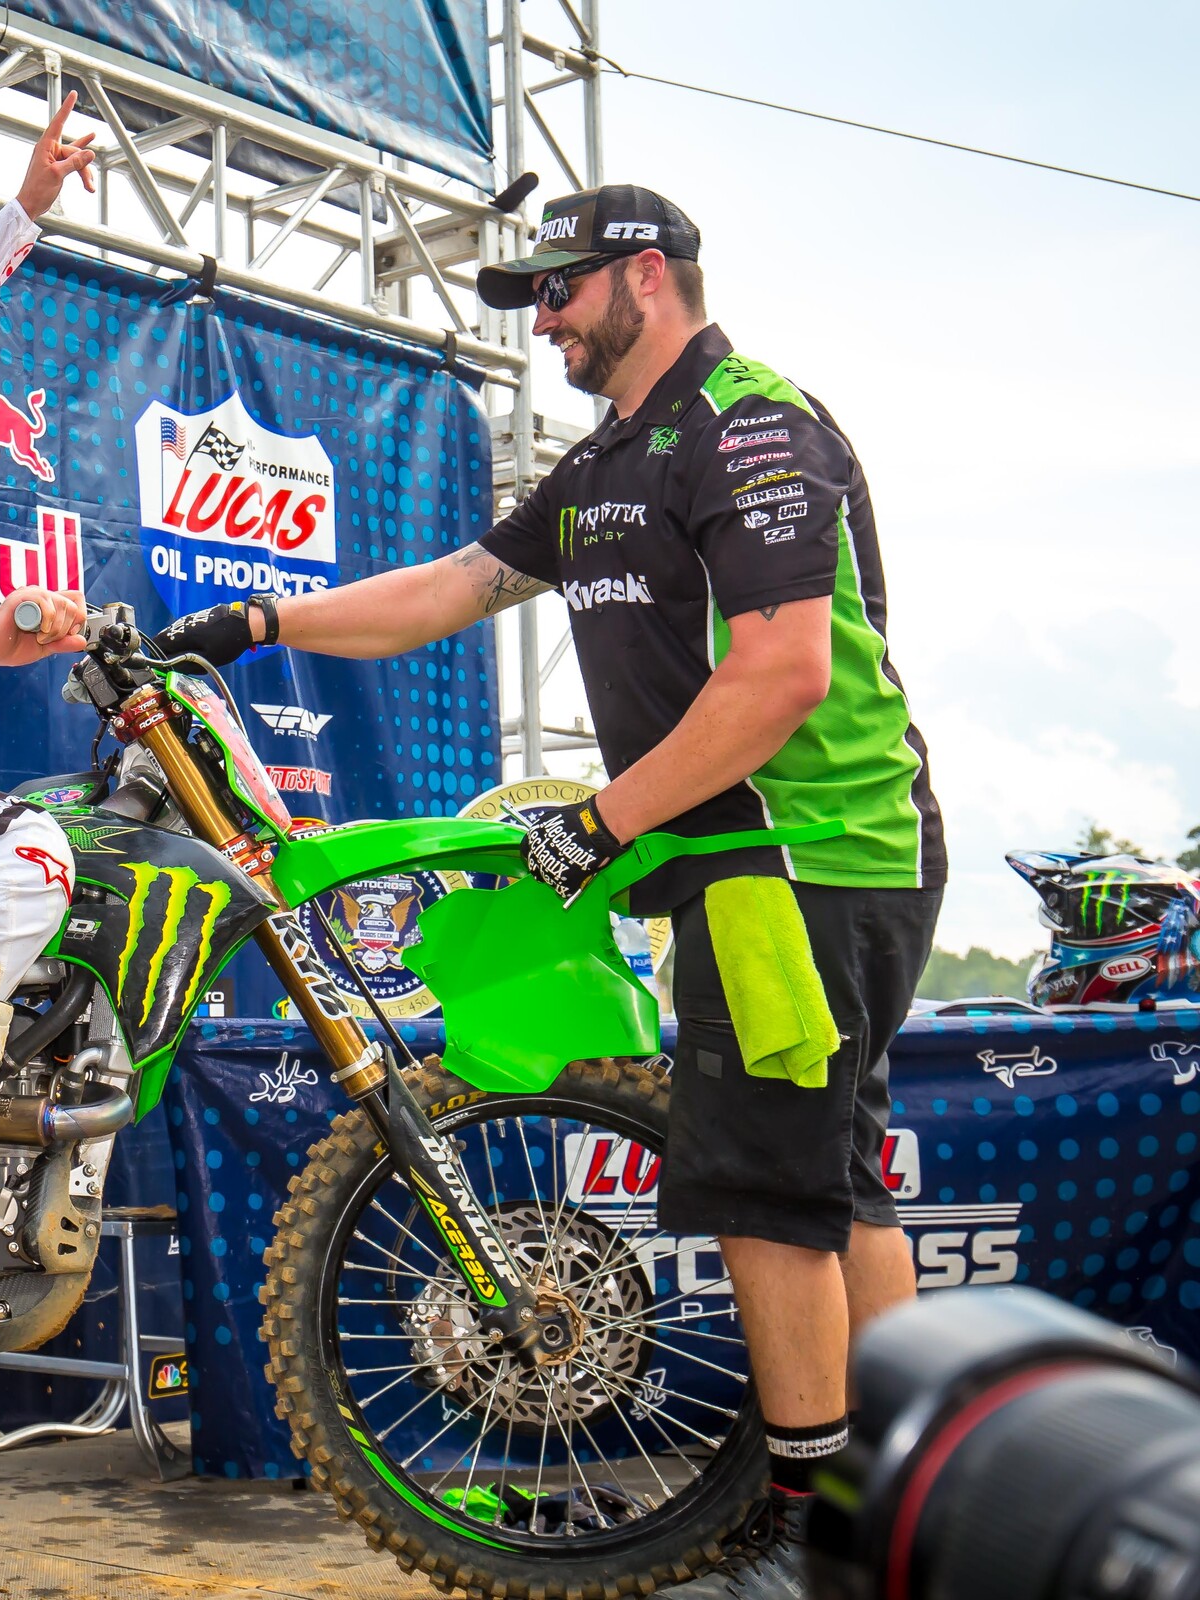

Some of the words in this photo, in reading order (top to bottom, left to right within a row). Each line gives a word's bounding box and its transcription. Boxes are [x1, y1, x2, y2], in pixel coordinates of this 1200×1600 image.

[602, 222, 660, 241] ET3
[720, 413, 783, 439] DUNLOP
[737, 482, 804, 508] HINSON
[162, 469, 327, 551] LUCAS
[779, 502, 807, 520] UNI
[151, 544, 188, 582] OIL
[195, 554, 329, 599] PRODUCTS
[274, 728, 318, 742] RACING
[1106, 960, 1145, 978] BELL
[363, 1002, 406, 1018] PACE
[409, 994, 431, 1012] 450
[418, 1134, 522, 1288] DUNLOP
